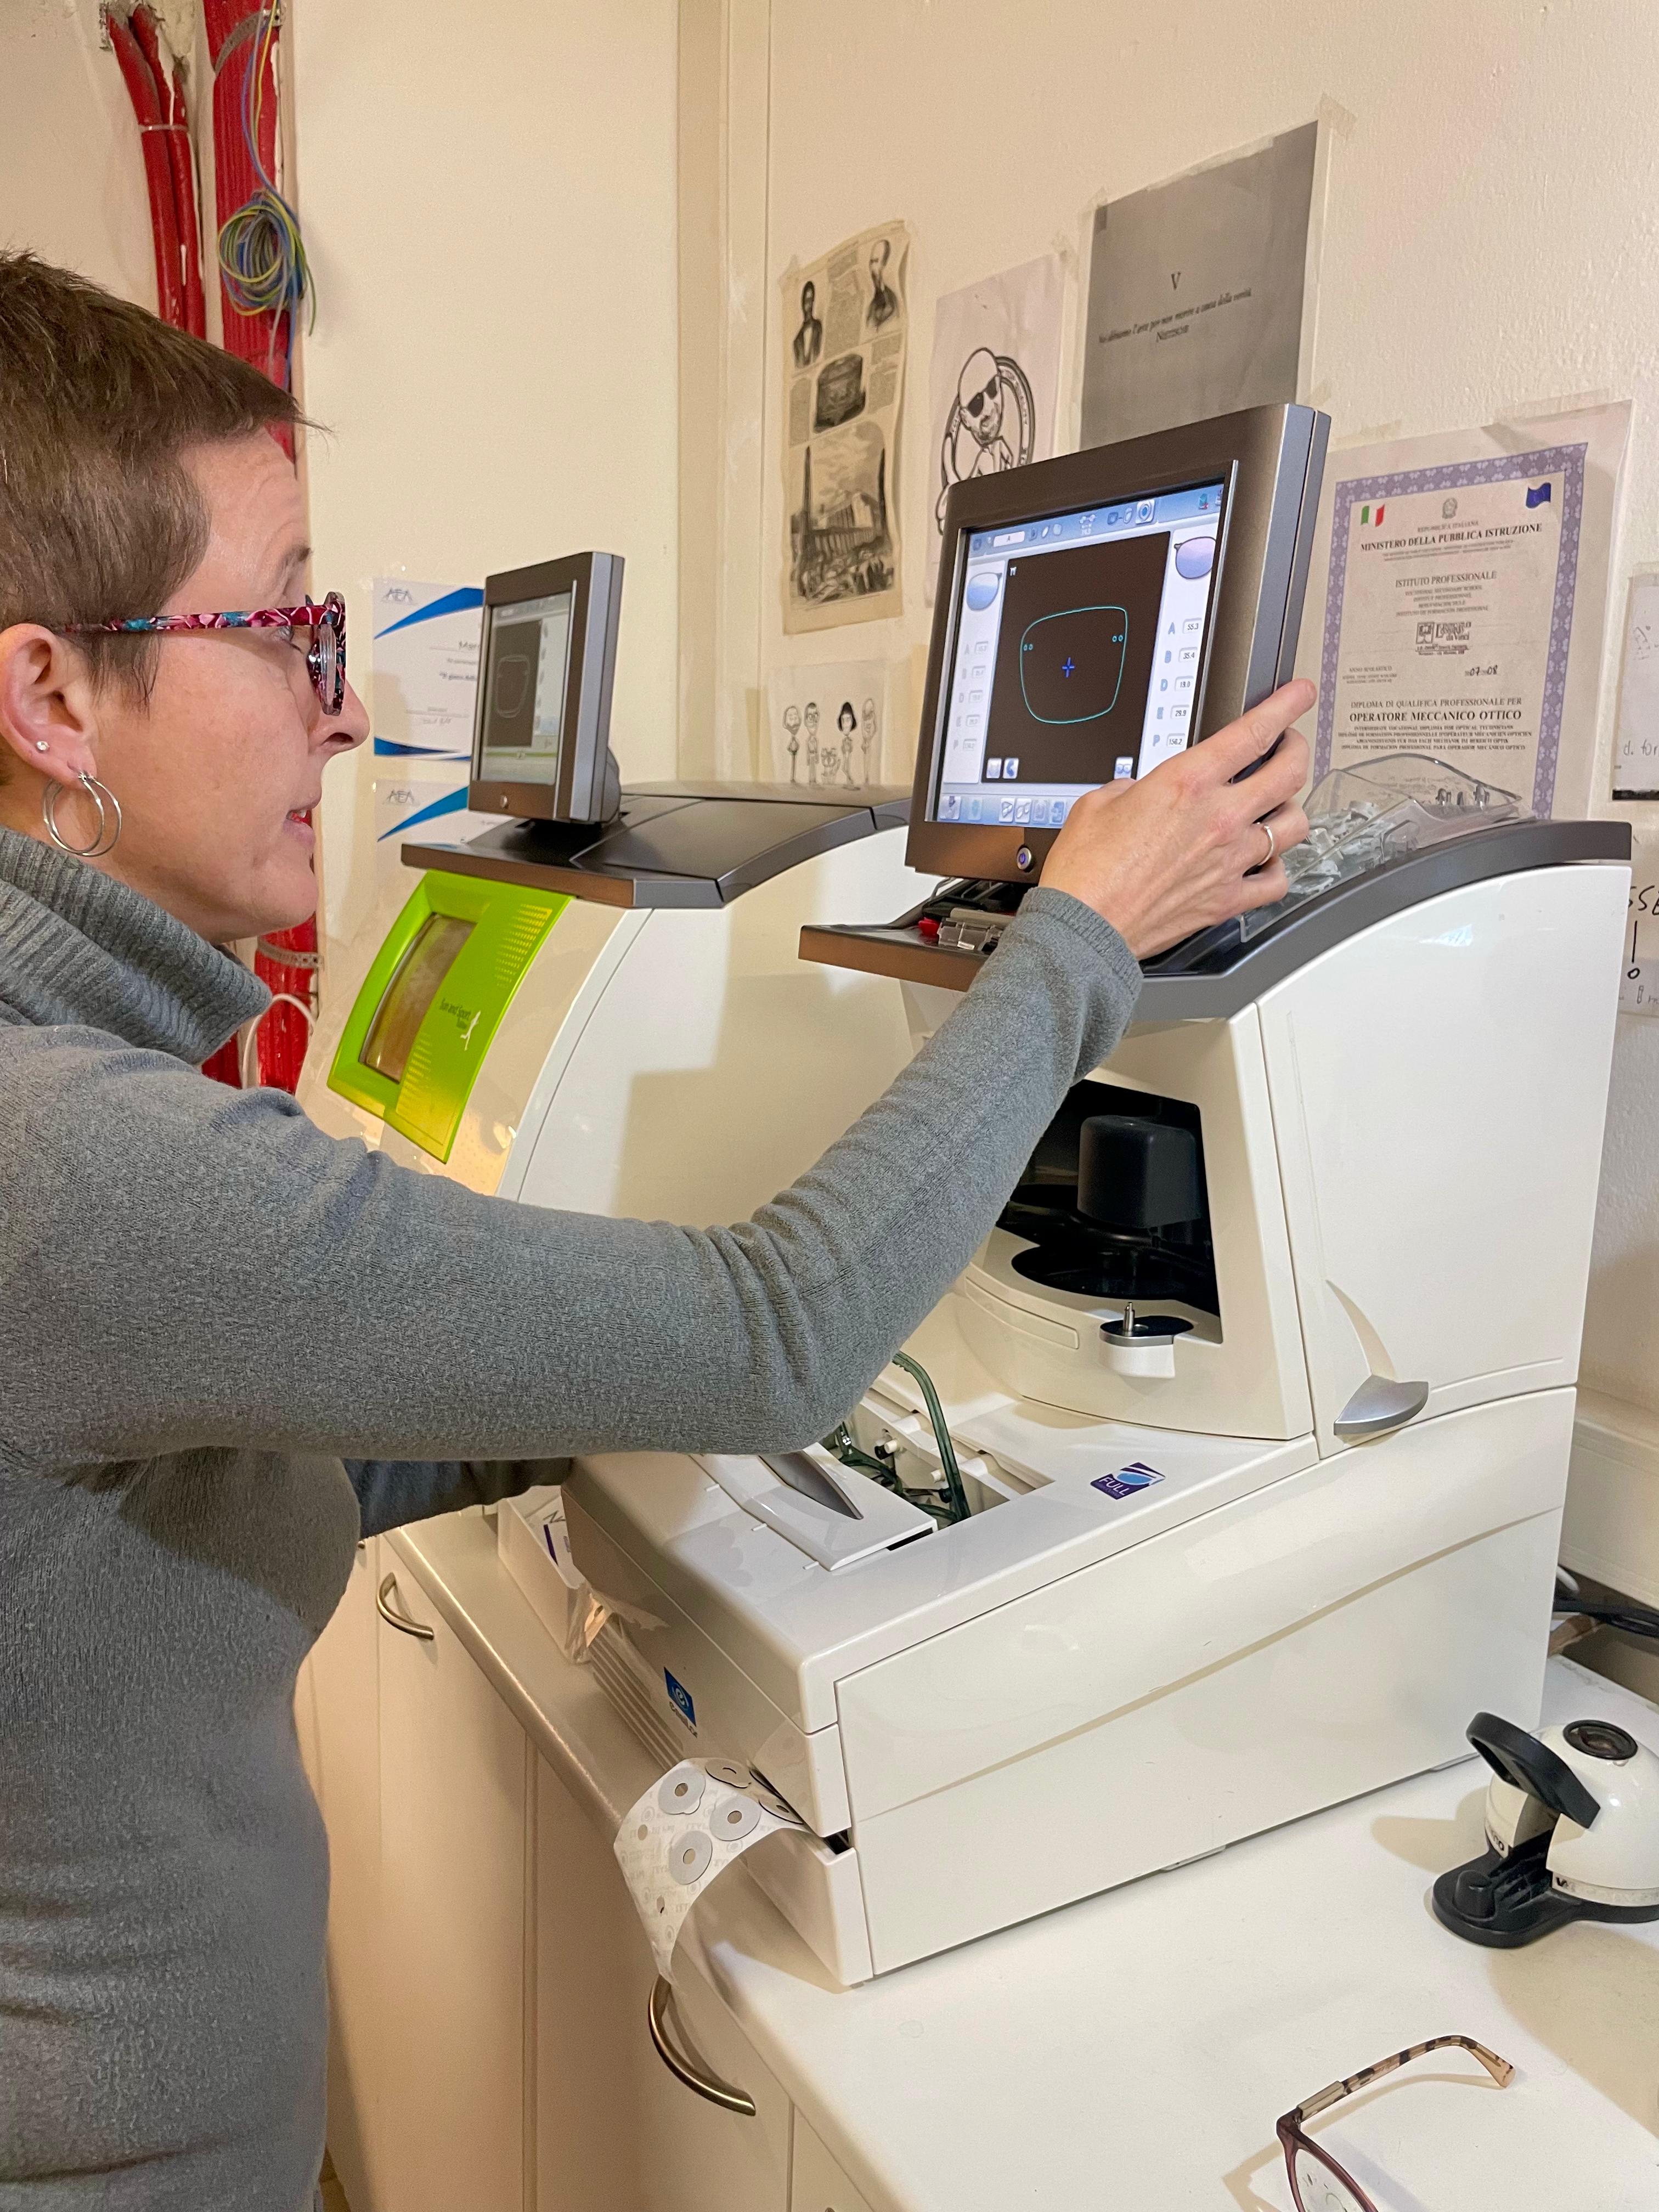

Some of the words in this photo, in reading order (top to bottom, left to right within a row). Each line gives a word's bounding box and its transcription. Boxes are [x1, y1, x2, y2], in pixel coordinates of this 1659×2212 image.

[1171, 272, 1181, 290] V
[1361, 539, 1406, 552] MINISTERO
[1408, 536, 1435, 546] DELLA
[1438, 530, 1482, 543] PUBBLICA
[1485, 523, 1542, 538] ISTRUZIONE
[1395, 577, 1430, 588] ISTITUTO
[1431, 571, 1497, 585] PROFESSIONALE
[1168, 622, 1175, 635] A
[1351, 701, 1383, 709] DIPLOMA
[1396, 699, 1437, 708] QUALIFICA
[1440, 697, 1505, 707] PROFESSIONALE
[1507, 697, 1522, 706] PER
[1350, 713, 1408, 722] OPERATORE
[1410, 710, 1475, 721] MECCANICO
[1479, 710, 1521, 720] OTTICO
[1640, 738, 1659, 756] for
[1098, 1476, 1130, 1496] FULL
